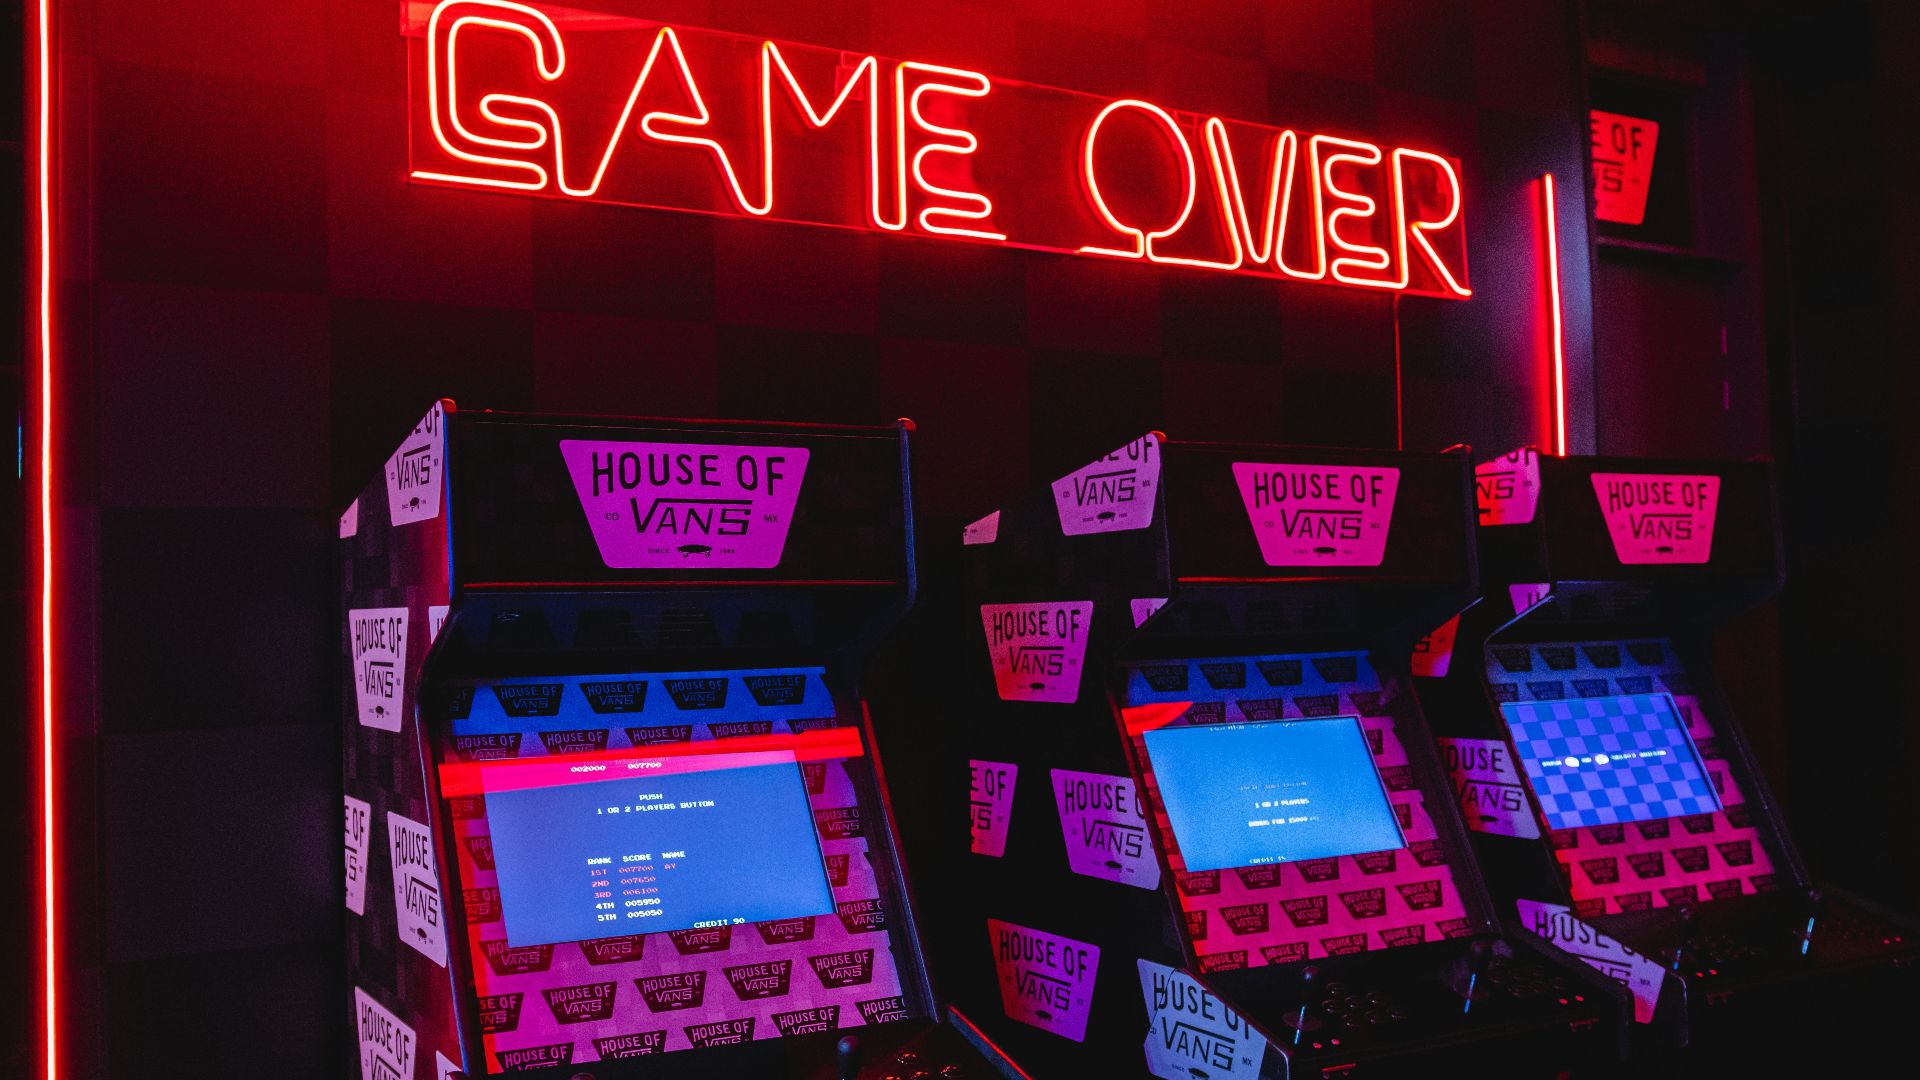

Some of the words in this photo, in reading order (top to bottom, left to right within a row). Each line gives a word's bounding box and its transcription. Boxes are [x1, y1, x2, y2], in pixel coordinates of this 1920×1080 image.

[411, 0, 1006, 240] GAME
[1077, 98, 1473, 297] OVER
[396, 444, 431, 490] VANS
[592, 452, 721, 497] HOUSE
[736, 454, 785, 496] OF
[1074, 468, 1136, 507] VANS
[1254, 471, 1342, 508] HOUSE
[1350, 474, 1384, 507] OF
[1476, 470, 1515, 501] NS
[1608, 481, 1675, 513] HOUSE
[1682, 482, 1707, 511] OF
[605, 512, 620, 521] CD
[630, 497, 753, 535] VANS
[764, 513, 779, 524] MX
[1280, 508, 1363, 539] VANS
[1629, 513, 1693, 540] VANS
[993, 610, 1050, 647] HOUSE
[1056, 609, 1081, 643] OF
[355, 617, 386, 661] HOUSE
[389, 617, 402, 659] OF
[1009, 645, 1065, 676] VANS
[363, 660, 394, 699] VANS
[588, 683, 623, 696] HOUSE
[627, 682, 641, 695] OF
[671, 680, 706, 692] HOUSE
[708, 679, 723, 690] OF
[501, 686, 539, 700] HOUSE
[541, 686, 558, 697] OF
[632, 728, 669, 742] HOUSE
[671, 727, 687, 738] OF
[715, 723, 751, 736] HOUSE
[753, 722, 769, 734] OF
[456, 736, 499, 750] HOUSE
[501, 735, 516, 747] OF
[546, 732, 585, 747] HOUSE
[588, 731, 603, 742] OF
[1446, 744, 1504, 773] OUSE
[807, 765, 822, 777] OF
[984, 768, 1007, 801] OF
[639, 793, 663, 801] PUSH
[1064, 779, 1127, 815] HOUSE
[607, 806, 620, 814] OR
[624, 805, 631, 813] 2
[635, 802, 676, 812] PLAYERS
[680, 800, 715, 809] BUTTON
[816, 810, 850, 825] HOUSE
[827, 819, 860, 832] VANS
[352, 807, 365, 848] OF
[1082, 817, 1144, 858] VANS
[394, 824, 429, 871] HOUSE
[587, 856, 612, 865] RANK
[622, 853, 652, 863] SCORE
[661, 850, 686, 859] NAME
[830, 856, 844, 868] OF
[591, 868, 607, 877] 1ST
[591, 880, 610, 888] 2ND
[403, 872, 438, 928] VANS
[594, 891, 612, 899] 3RD
[595, 902, 615, 910] 4TH
[840, 901, 873, 917] HOUSE
[1224, 906, 1253, 921] HOUSE
[1253, 905, 1265, 916] OF
[597, 913, 617, 922] 5TH
[693, 918, 728, 929] CREDIT
[851, 911, 885, 925] VANS
[769, 921, 804, 936] VANS
[683, 931, 720, 946] VANS
[594, 941, 632, 956] VANS
[999, 929, 1057, 968] HOUSE
[1063, 945, 1088, 983] OF
[501, 951, 541, 967] VANS
[815, 954, 852, 972] HOUSE
[854, 951, 869, 965] OF
[1202, 954, 1230, 968] HOUSE
[1232, 951, 1244, 963] OF
[731, 965, 769, 983] HOUSE
[771, 962, 787, 975] OF
[828, 965, 862, 980] VANS
[643, 976, 682, 994] HOUSE
[684, 973, 701, 987] OF
[743, 976, 779, 991] VANS
[1015, 965, 1072, 1011] VANS
[499, 996, 517, 1010] OF
[550, 987, 592, 1006] HOUSE
[594, 984, 612, 999] OF
[655, 987, 693, 1003] VANS
[563, 999, 602, 1015] VANS
[863, 998, 899, 1017] HOUSE
[779, 1011, 817, 1030] HOUSE
[819, 1008, 835, 1021] OF
[361, 1001, 393, 1054] HOUSE
[395, 1027, 410, 1075] OF
[692, 1023, 731, 1043] HOUSE
[733, 1020, 750, 1034] OF
[600, 1035, 641, 1056] HOUSE
[644, 1033, 661, 1047] OF
[1161, 1017, 1236, 1072] VANS
[1242, 1056, 1252, 1067] MX
[504, 1049, 547, 1070] HOUSE
[550, 1045, 568, 1060] OF
